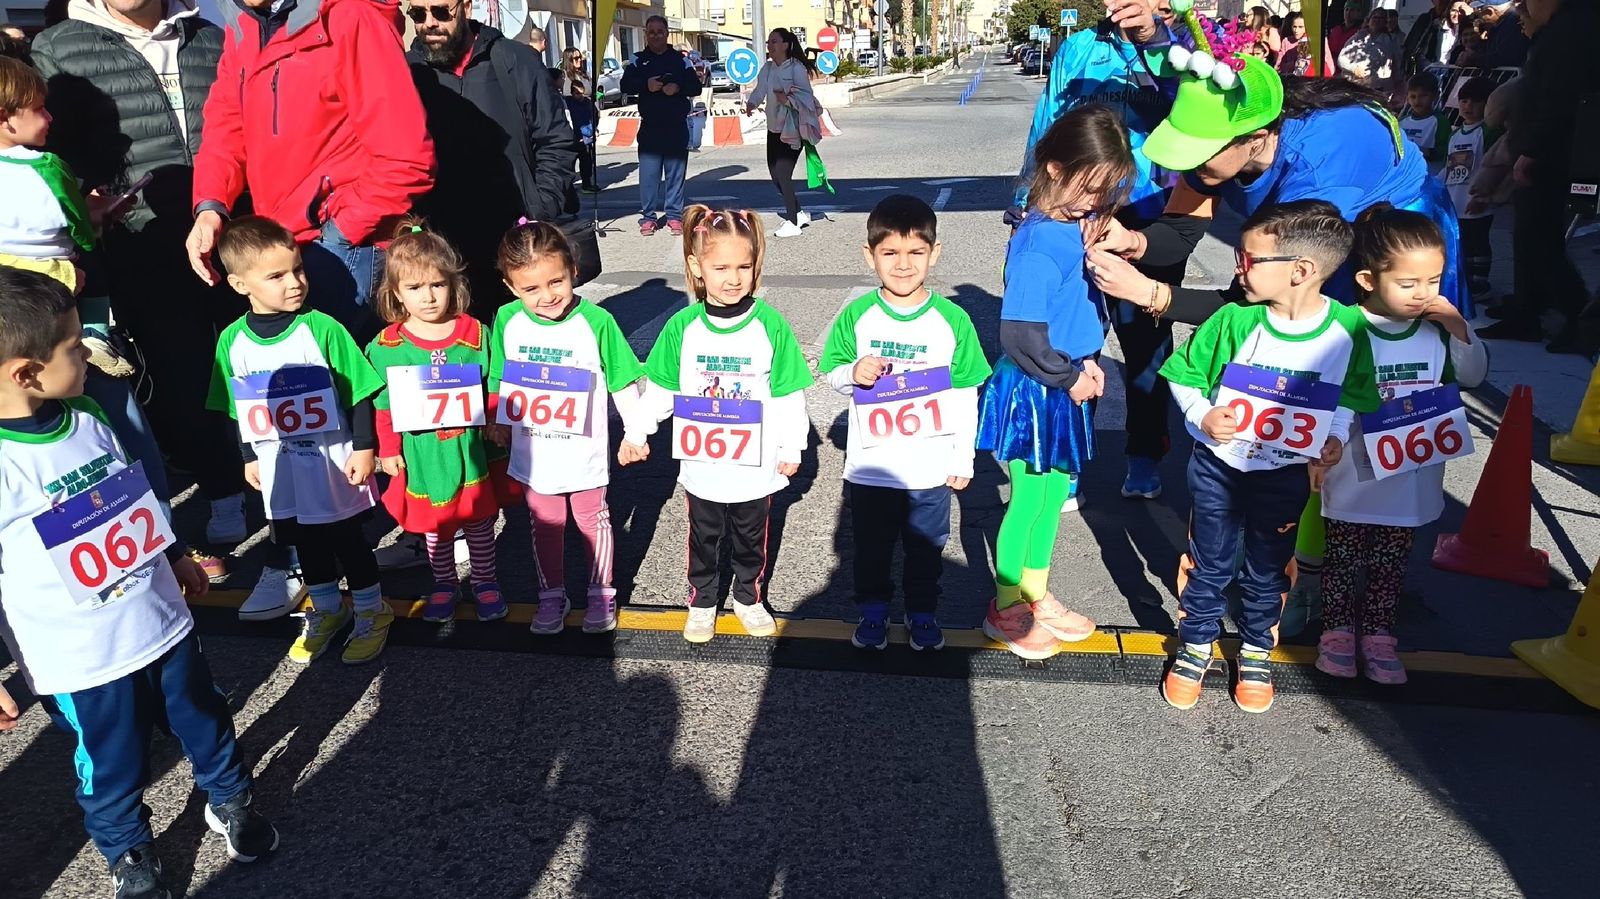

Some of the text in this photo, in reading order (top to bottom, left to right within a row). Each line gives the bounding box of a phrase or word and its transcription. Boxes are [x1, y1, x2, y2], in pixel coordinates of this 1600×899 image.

[608, 110, 640, 118] BIENVE
[709, 108, 736, 116] ILLA
[1451, 168, 1467, 180] 399
[248, 396, 328, 436] 065
[427, 392, 472, 424] 71
[506, 390, 577, 428] 064
[868, 399, 942, 438] 061
[1227, 398, 1317, 449] 063
[681, 425, 752, 460] 067
[1377, 417, 1463, 470] 066
[103, 505, 111, 513] DE
[70, 507, 166, 588] 062
